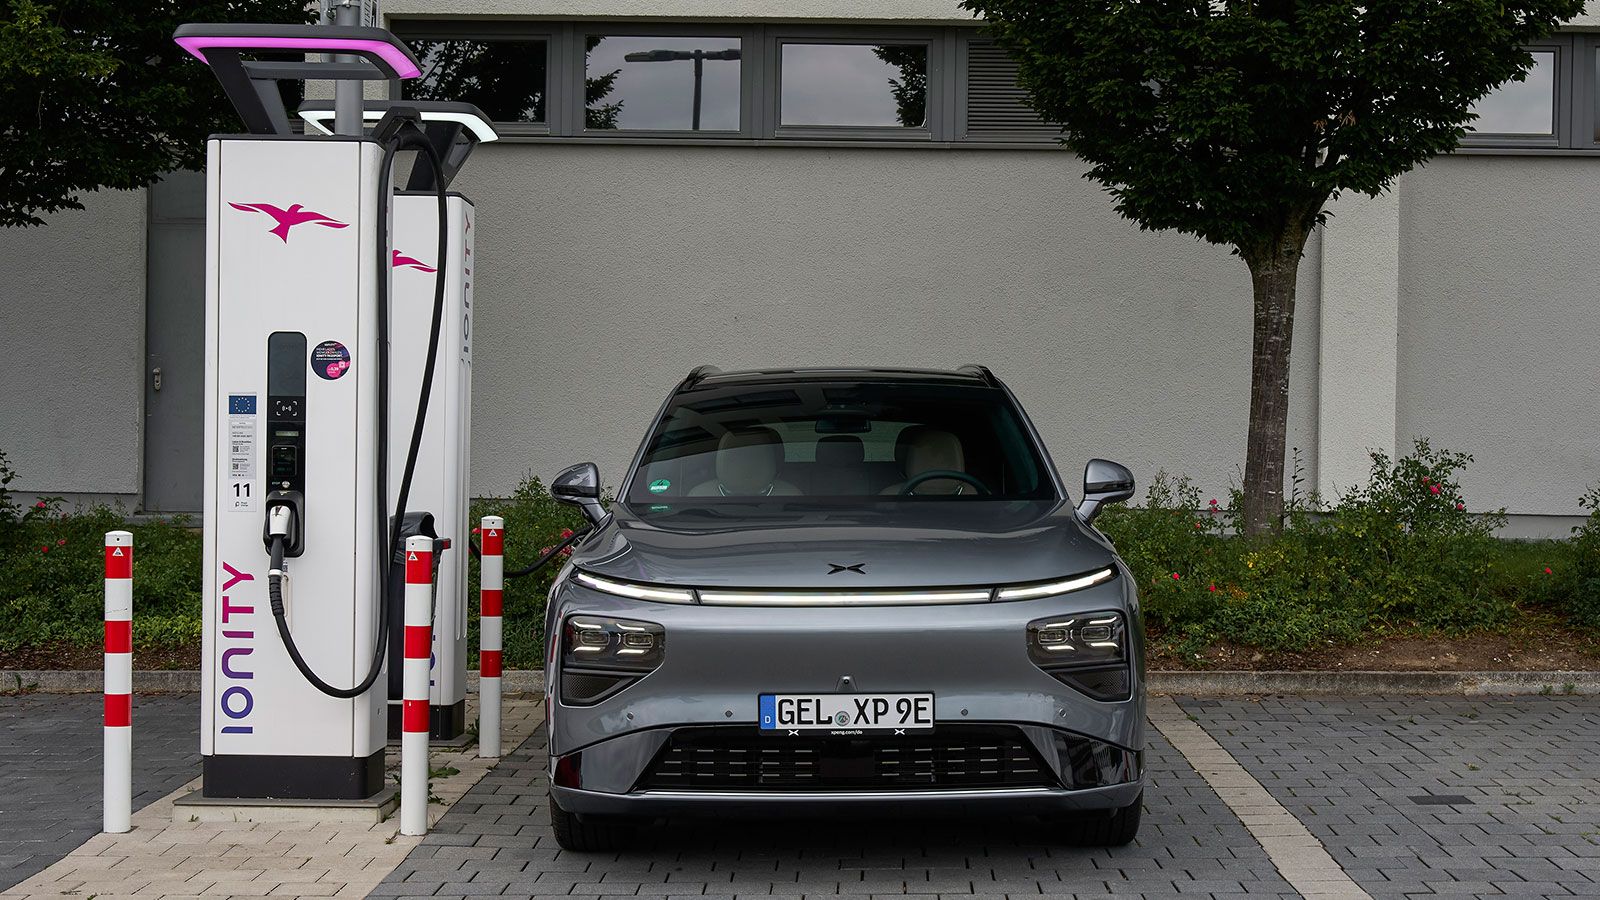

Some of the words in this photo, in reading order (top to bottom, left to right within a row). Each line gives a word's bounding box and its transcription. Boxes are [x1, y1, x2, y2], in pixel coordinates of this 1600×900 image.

[233, 482, 250, 497] 11
[221, 561, 255, 734] IONITY
[764, 715, 771, 724] D
[777, 698, 833, 725] GEL
[853, 698, 889, 725] XP
[895, 697, 931, 725] 9E
